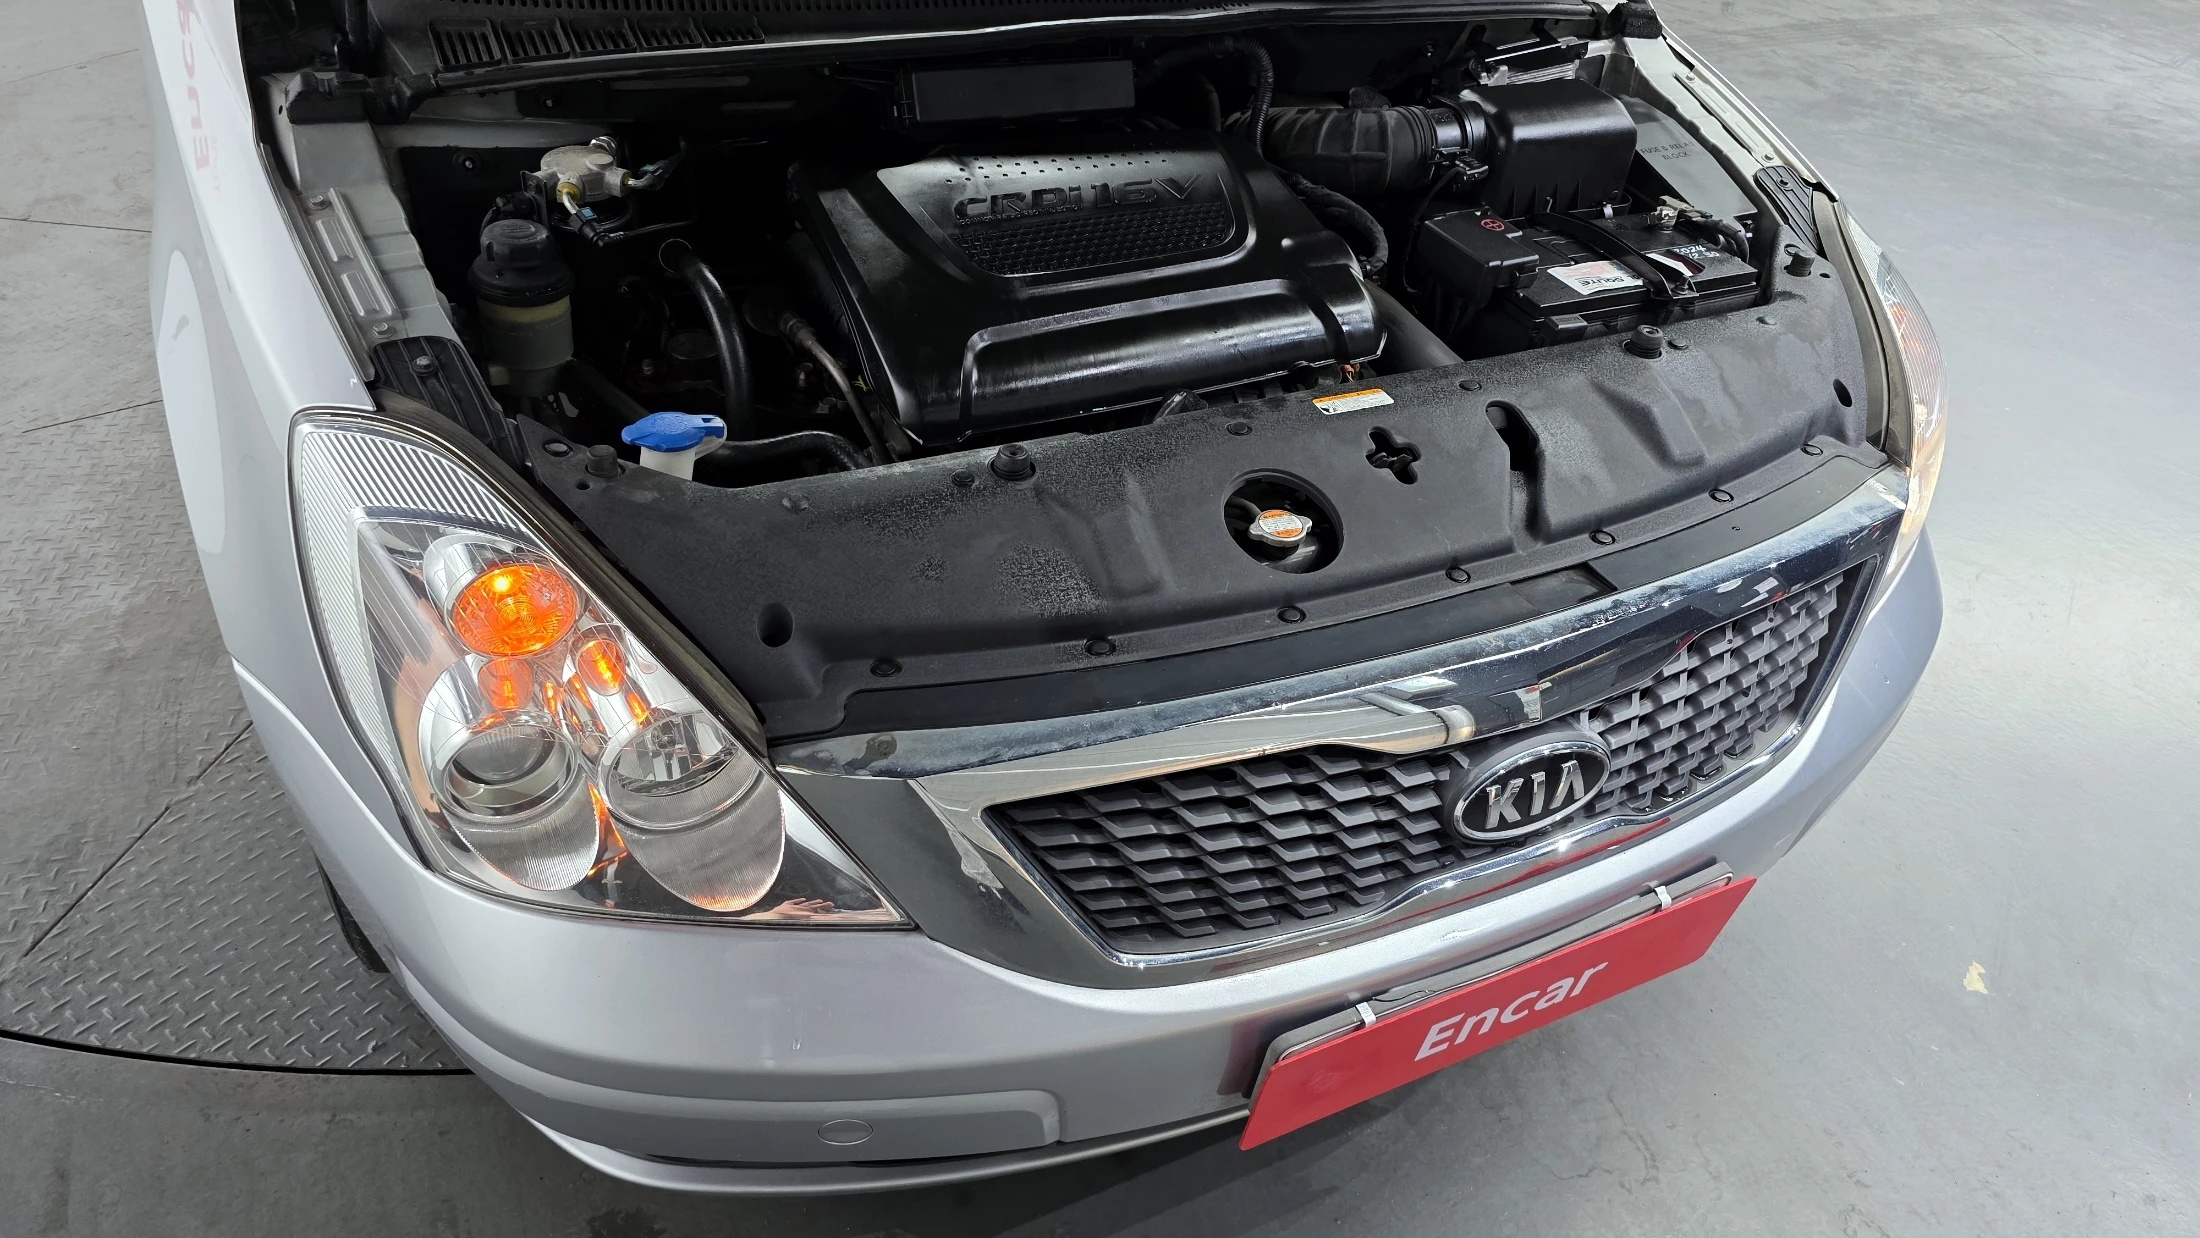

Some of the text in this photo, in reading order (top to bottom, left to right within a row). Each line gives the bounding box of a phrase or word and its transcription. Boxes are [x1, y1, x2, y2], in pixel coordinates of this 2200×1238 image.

[1640, 146, 1661, 154] FUSE
[1669, 141, 1695, 150] RELAY
[1661, 151, 1691, 160] BLOCK
[1672, 244, 1707, 254] 2024
[1484, 759, 1585, 830] KIA
[1414, 961, 1608, 1062] Encar
